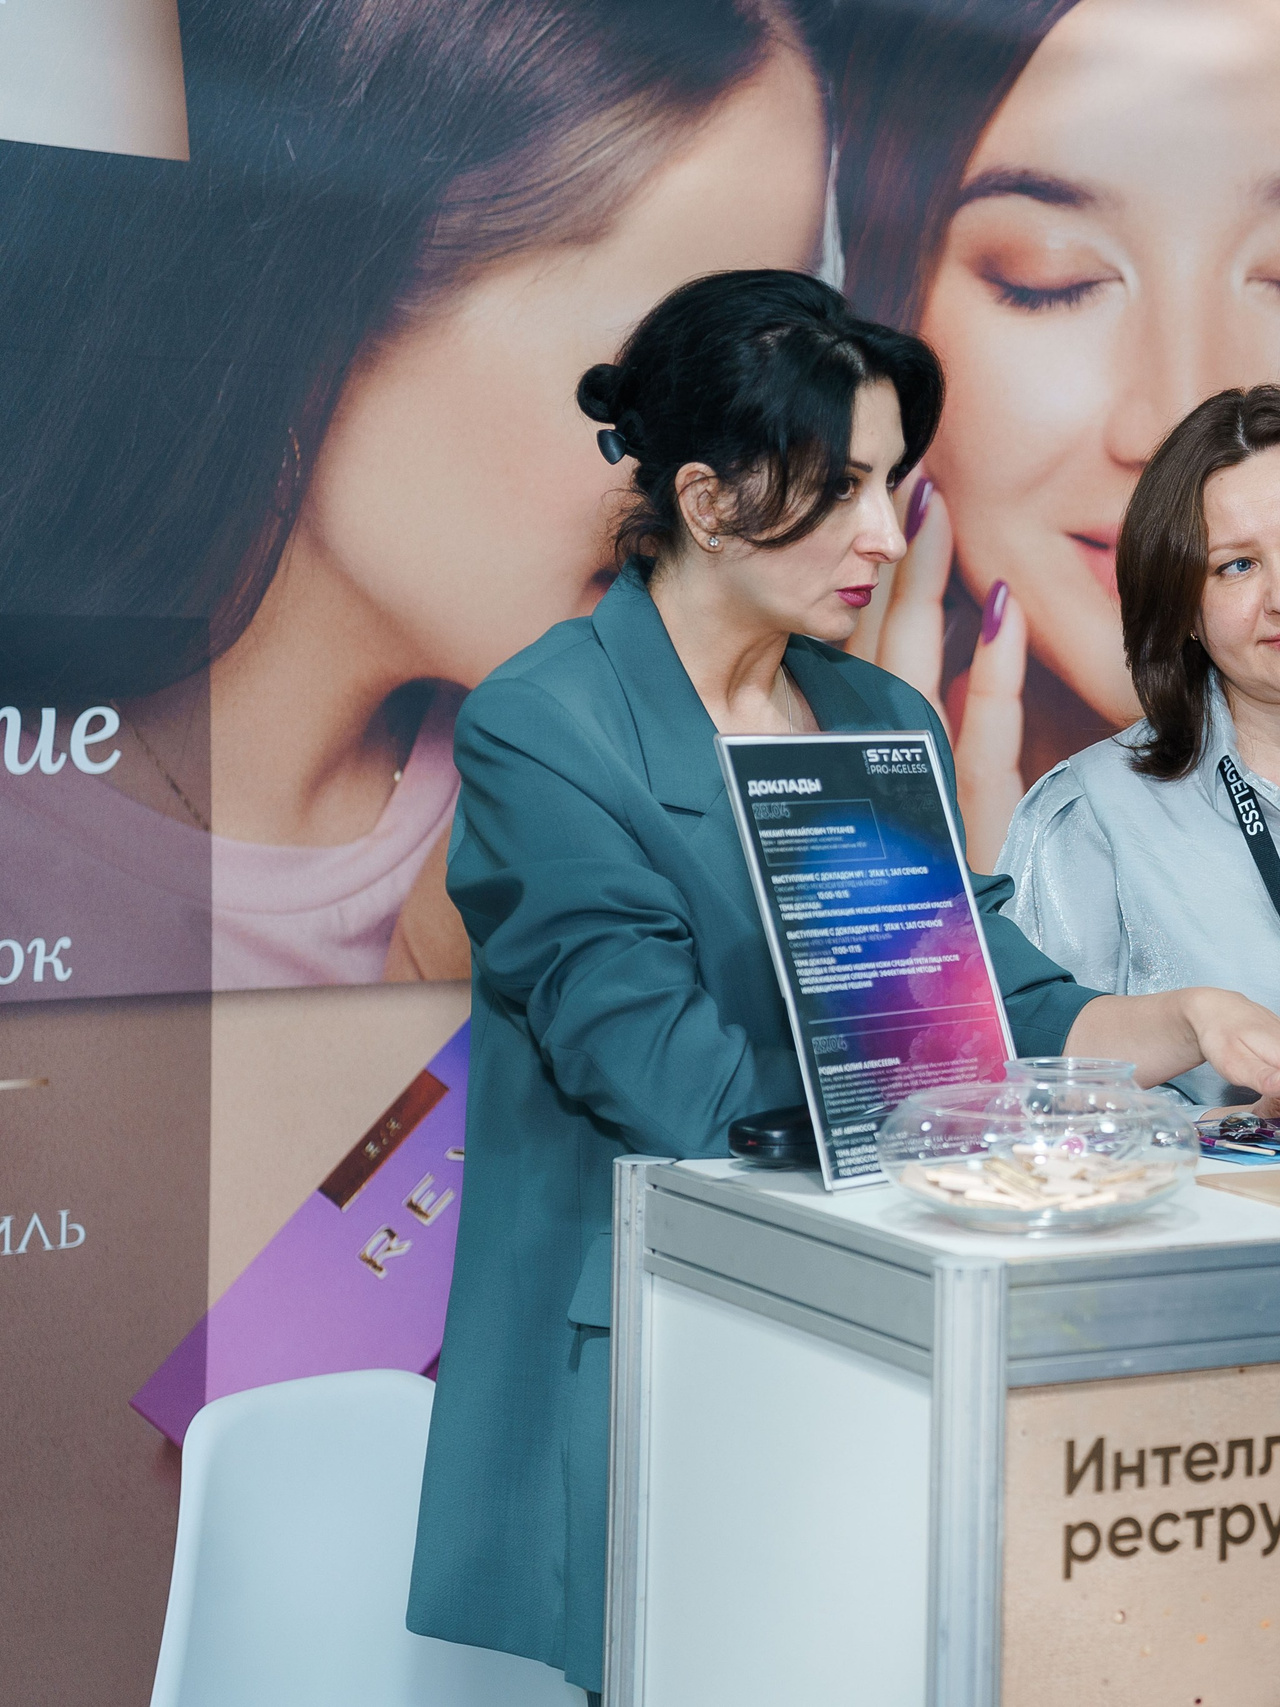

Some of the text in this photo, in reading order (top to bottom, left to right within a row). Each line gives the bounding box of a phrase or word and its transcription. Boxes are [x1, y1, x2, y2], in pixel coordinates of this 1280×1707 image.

[867, 748, 923, 763] START
[869, 763, 928, 775] PRO-AGELESS
[748, 778, 822, 797] ДОКЛАДЫ
[890, 867, 902, 877] ЗАЛ
[905, 920, 917, 930] ЗАЛ
[0, 936, 73, 985] ок
